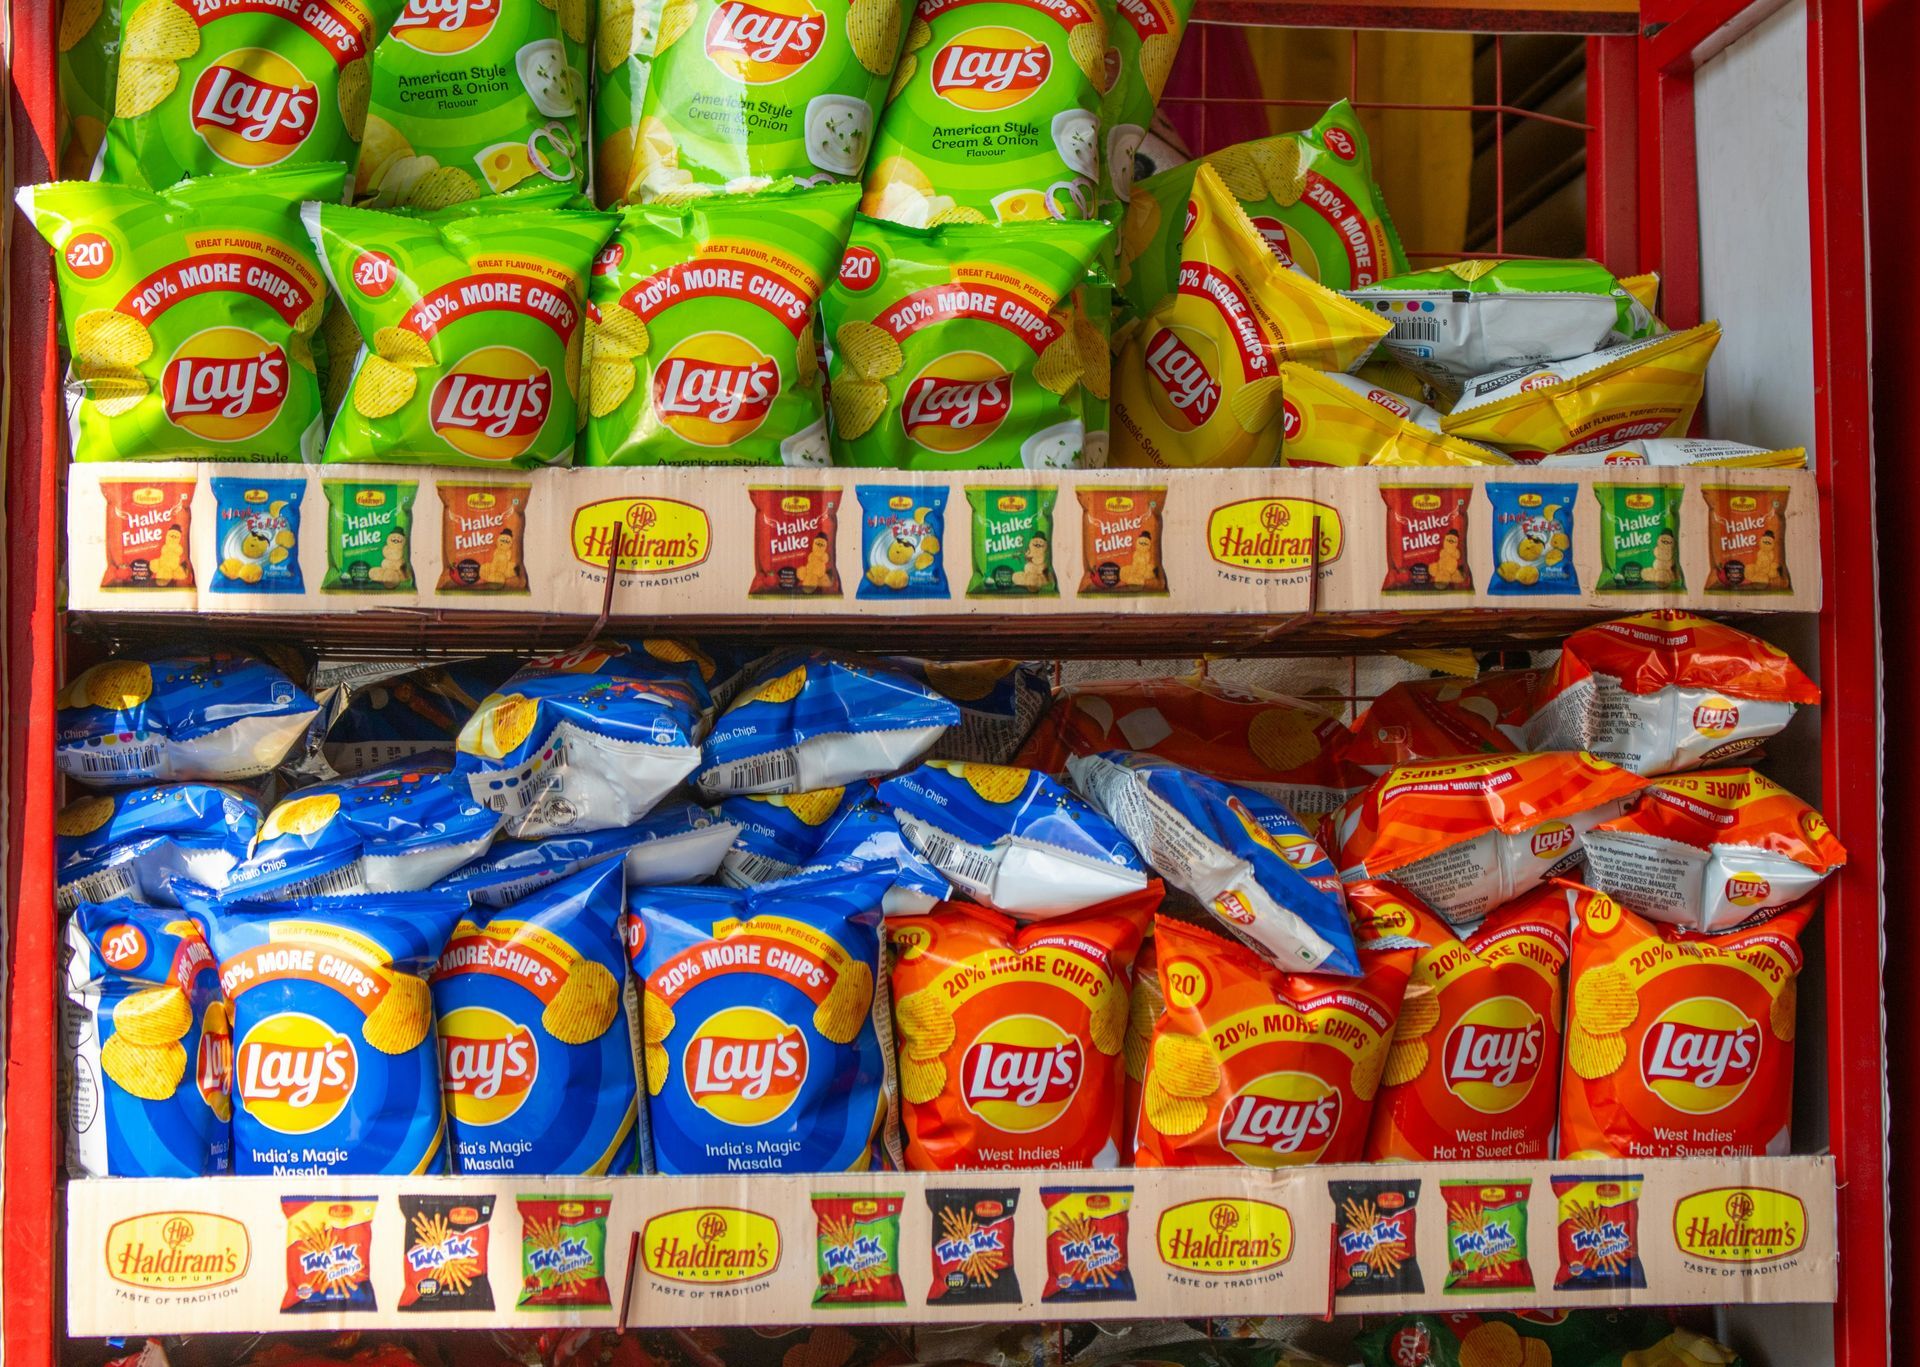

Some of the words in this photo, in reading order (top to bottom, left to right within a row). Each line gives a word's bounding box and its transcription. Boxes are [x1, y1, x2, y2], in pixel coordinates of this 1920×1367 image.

[710, 2, 820, 63] Lay's
[398, 68, 468, 88] American
[470, 65, 507, 81] Style
[939, 46, 1046, 92] Lay's
[400, 87, 449, 103] Cream
[452, 84, 464, 96] &
[466, 80, 509, 94] Onion
[197, 67, 313, 142] Lay's
[437, 98, 479, 110] Flavour
[757, 101, 793, 119] Style
[688, 106, 734, 123] Cream
[748, 113, 788, 133] Onion
[932, 124, 1000, 138] American
[1004, 122, 1039, 136] Style
[932, 136, 979, 150] Cream
[983, 136, 993, 147] &
[997, 133, 1039, 147] Onion
[966, 149, 1006, 158] Flavour
[1308, 183, 1343, 219] 20%
[1340, 214, 1371, 269] MORE
[195, 239, 222, 249] GREAT
[224, 238, 263, 253] FLAVOUR,
[265, 245, 296, 267] PERFECT
[477, 260, 502, 268] GREAT
[771, 256, 804, 279] PERFECT
[957, 268, 983, 278] GREAT
[133, 278, 178, 317] 20%
[179, 263, 241, 290] MORE
[634, 277, 680, 313] 20%
[682, 268, 744, 291] MORE
[1203, 273, 1246, 318] MORE
[414, 294, 459, 332] 20%
[460, 283, 521, 306] MORE
[890, 299, 934, 333] 20%
[938, 292, 997, 315] MORE
[1147, 333, 1217, 414] Lay's
[173, 352, 282, 418] Lay's
[663, 360, 773, 423] Lay's
[437, 374, 547, 438] Lay's
[908, 378, 1008, 429] Lay's
[1115, 403, 1143, 442] Classic
[128, 509, 172, 528] Halke
[347, 512, 391, 530] Halke
[460, 514, 503, 531] Halke
[776, 518, 818, 537] Halke
[990, 518, 1032, 535] Halke
[1100, 518, 1141, 535] Halke
[1408, 516, 1449, 534] Halke
[1619, 515, 1660, 532] Halke
[1726, 517, 1764, 534] Halke
[122, 527, 163, 547] Fulke
[341, 529, 382, 549] Fulke
[455, 532, 494, 549] Fulke
[770, 536, 809, 555] Fulke
[985, 536, 1023, 554] Fulke
[1095, 535, 1132, 553] Fulke
[1402, 533, 1440, 551] Fulke
[1614, 533, 1652, 550] Fulke
[1721, 534, 1756, 551] Fulke
[620, 579, 634, 588] OF
[639, 572, 700, 588] TRADITION
[1217, 570, 1250, 584] TASTE
[1256, 578, 1269, 586] OF
[1695, 707, 1737, 730] Lay's
[64, 729, 89, 740] Chips
[706, 732, 731, 748] Potato
[732, 724, 757, 739] Chips
[899, 775, 924, 797] Potato
[925, 788, 948, 807] Chips
[1705, 780, 1750, 800] MORE
[752, 824, 776, 839] Chips
[1534, 826, 1573, 851] Lay's
[232, 869, 260, 885] Potato
[261, 858, 287, 875] Chips
[1620, 873, 1647, 885] SERVICES
[1601, 877, 1619, 888] INDIA
[1620, 881, 1655, 895] HOLDINGS
[1729, 878, 1769, 898] Lay's
[786, 928, 819, 944] PERFECT
[1521, 925, 1554, 939] PERFECT
[443, 946, 487, 971] MORE
[1429, 947, 1470, 980] 20%
[1630, 944, 1673, 976] 20%
[221, 963, 254, 997] 20%
[257, 950, 314, 973] MORE
[659, 960, 700, 996] 20%
[702, 945, 760, 970] MORE
[943, 964, 986, 999] 20%
[989, 955, 1045, 975] MORE
[1213, 1020, 1258, 1051] 20%
[1264, 1014, 1319, 1034] MORE
[1451, 1024, 1541, 1087] Lay's
[1648, 1026, 1755, 1088] Lay's
[244, 1042, 348, 1107] Lay's
[695, 1034, 799, 1100] Lay's
[970, 1043, 1076, 1107] Lay's
[1226, 1096, 1335, 1153] Lay's
[1456, 1128, 1488, 1142] West
[1491, 1126, 1527, 1140] Indies'
[1654, 1127, 1689, 1141] West
[1692, 1128, 1735, 1142] Indies'
[252, 1148, 299, 1163] India's
[303, 1149, 348, 1165] Magic
[490, 1140, 532, 1156] Magic
[706, 1142, 753, 1156] India's
[757, 1141, 801, 1156] Magic
[978, 1148, 1015, 1161] West
[1018, 1146, 1063, 1160] Indies'
[1434, 1145, 1457, 1159] Hot
[1477, 1143, 1512, 1158] Sweet
[1516, 1140, 1540, 1154] Chilli
[1629, 1142, 1654, 1156] Hot
[1676, 1144, 1718, 1157] Sweet
[1721, 1145, 1752, 1157] Chilli
[273, 1165, 328, 1175] Masala
[464, 1157, 514, 1170] Masala
[728, 1156, 782, 1171] Masala
[1686, 1217, 1796, 1248] Haldiram's
[654, 1237, 768, 1268] Haldiram's
[1169, 1228, 1282, 1259] Haldiram's
[1482, 1238, 1516, 1257] Gathiya
[1599, 1241, 1631, 1258] Gathiya
[118, 1243, 237, 1274] Haldiram's
[558, 1254, 593, 1273] Gathiya
[852, 1252, 887, 1272] Gathiya
[1087, 1252, 1120, 1271] Gathiya
[328, 1262, 361, 1280] Gathiya
[1683, 1261, 1717, 1276] TASTE
[1722, 1268, 1736, 1277] OF
[1741, 1260, 1798, 1277] TRADITION
[1167, 1273, 1200, 1288] TASTE
[1224, 1272, 1284, 1289] TRADITION
[115, 1289, 151, 1304] TASTE
[177, 1287, 238, 1304] TRADITION
[650, 1282, 685, 1298] TASTE
[710, 1282, 770, 1299] TRADITION
